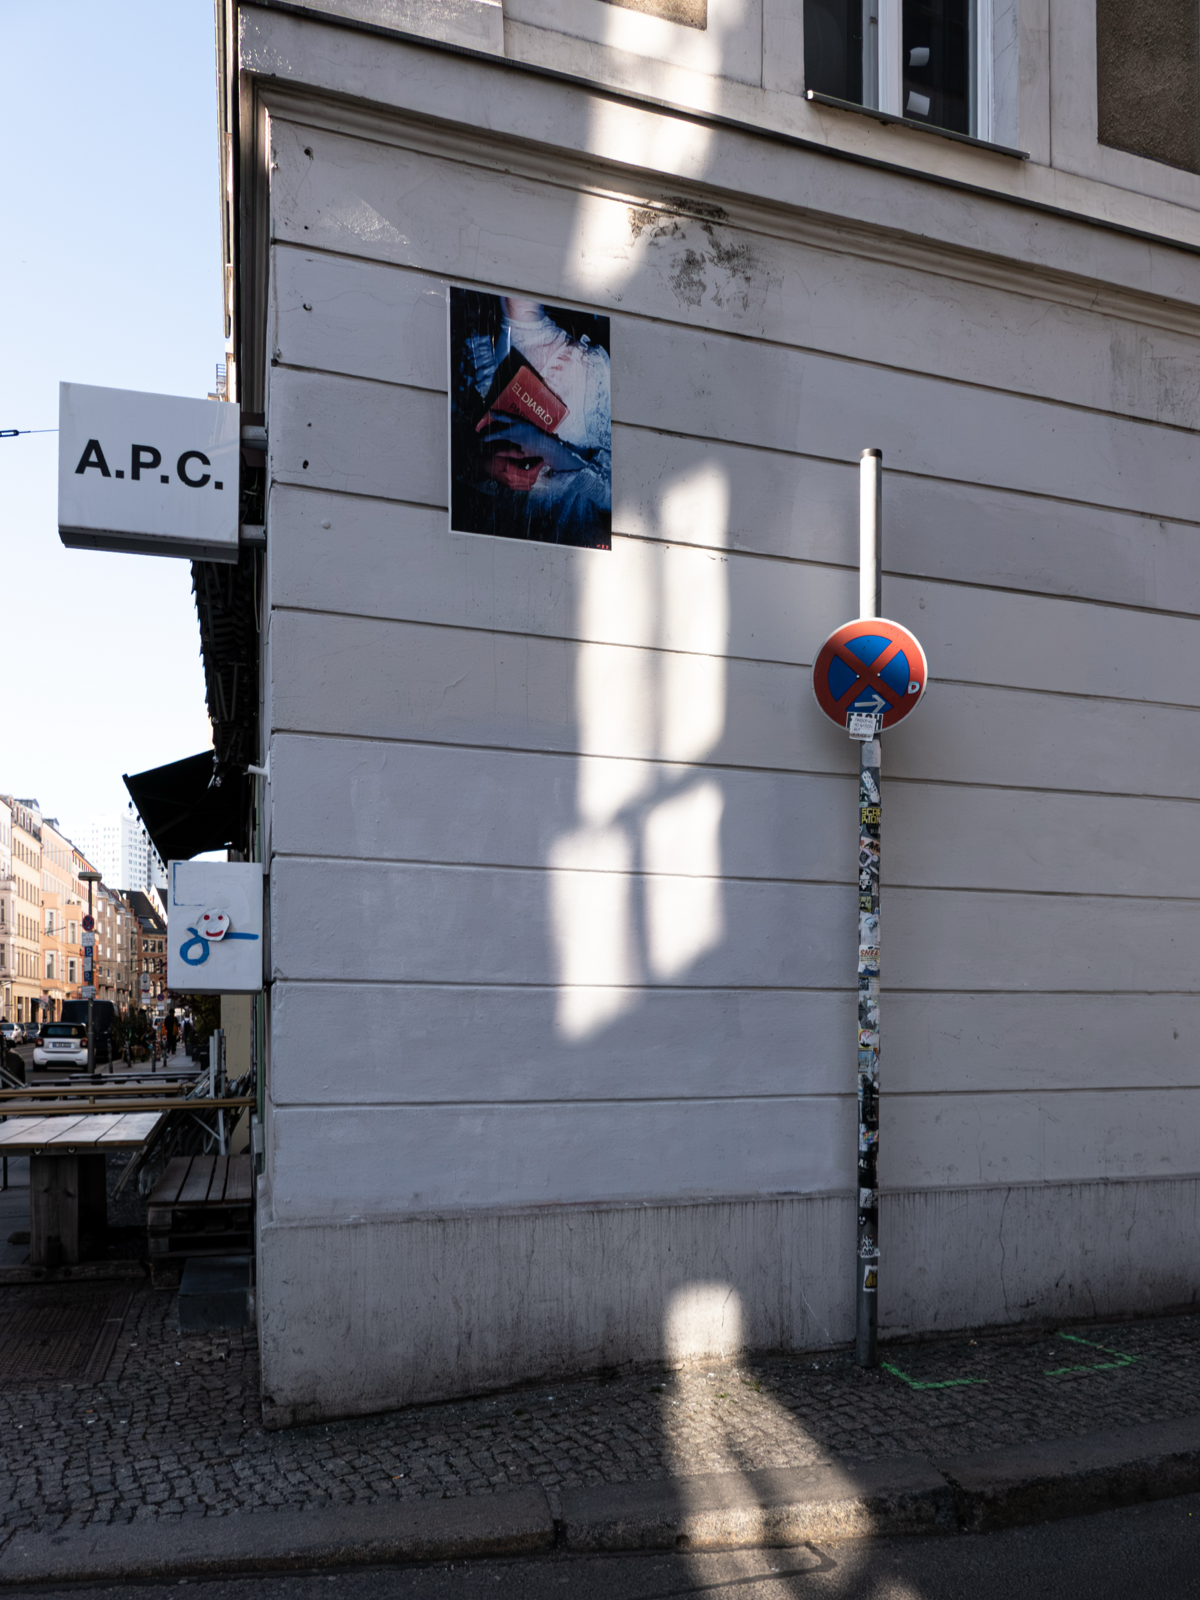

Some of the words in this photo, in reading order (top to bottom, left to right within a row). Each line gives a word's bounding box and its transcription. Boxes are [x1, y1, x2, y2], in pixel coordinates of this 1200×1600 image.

[511, 382, 522, 397] EL
[521, 392, 553, 426] DIABLO
[74, 438, 224, 491] A.P.C.
